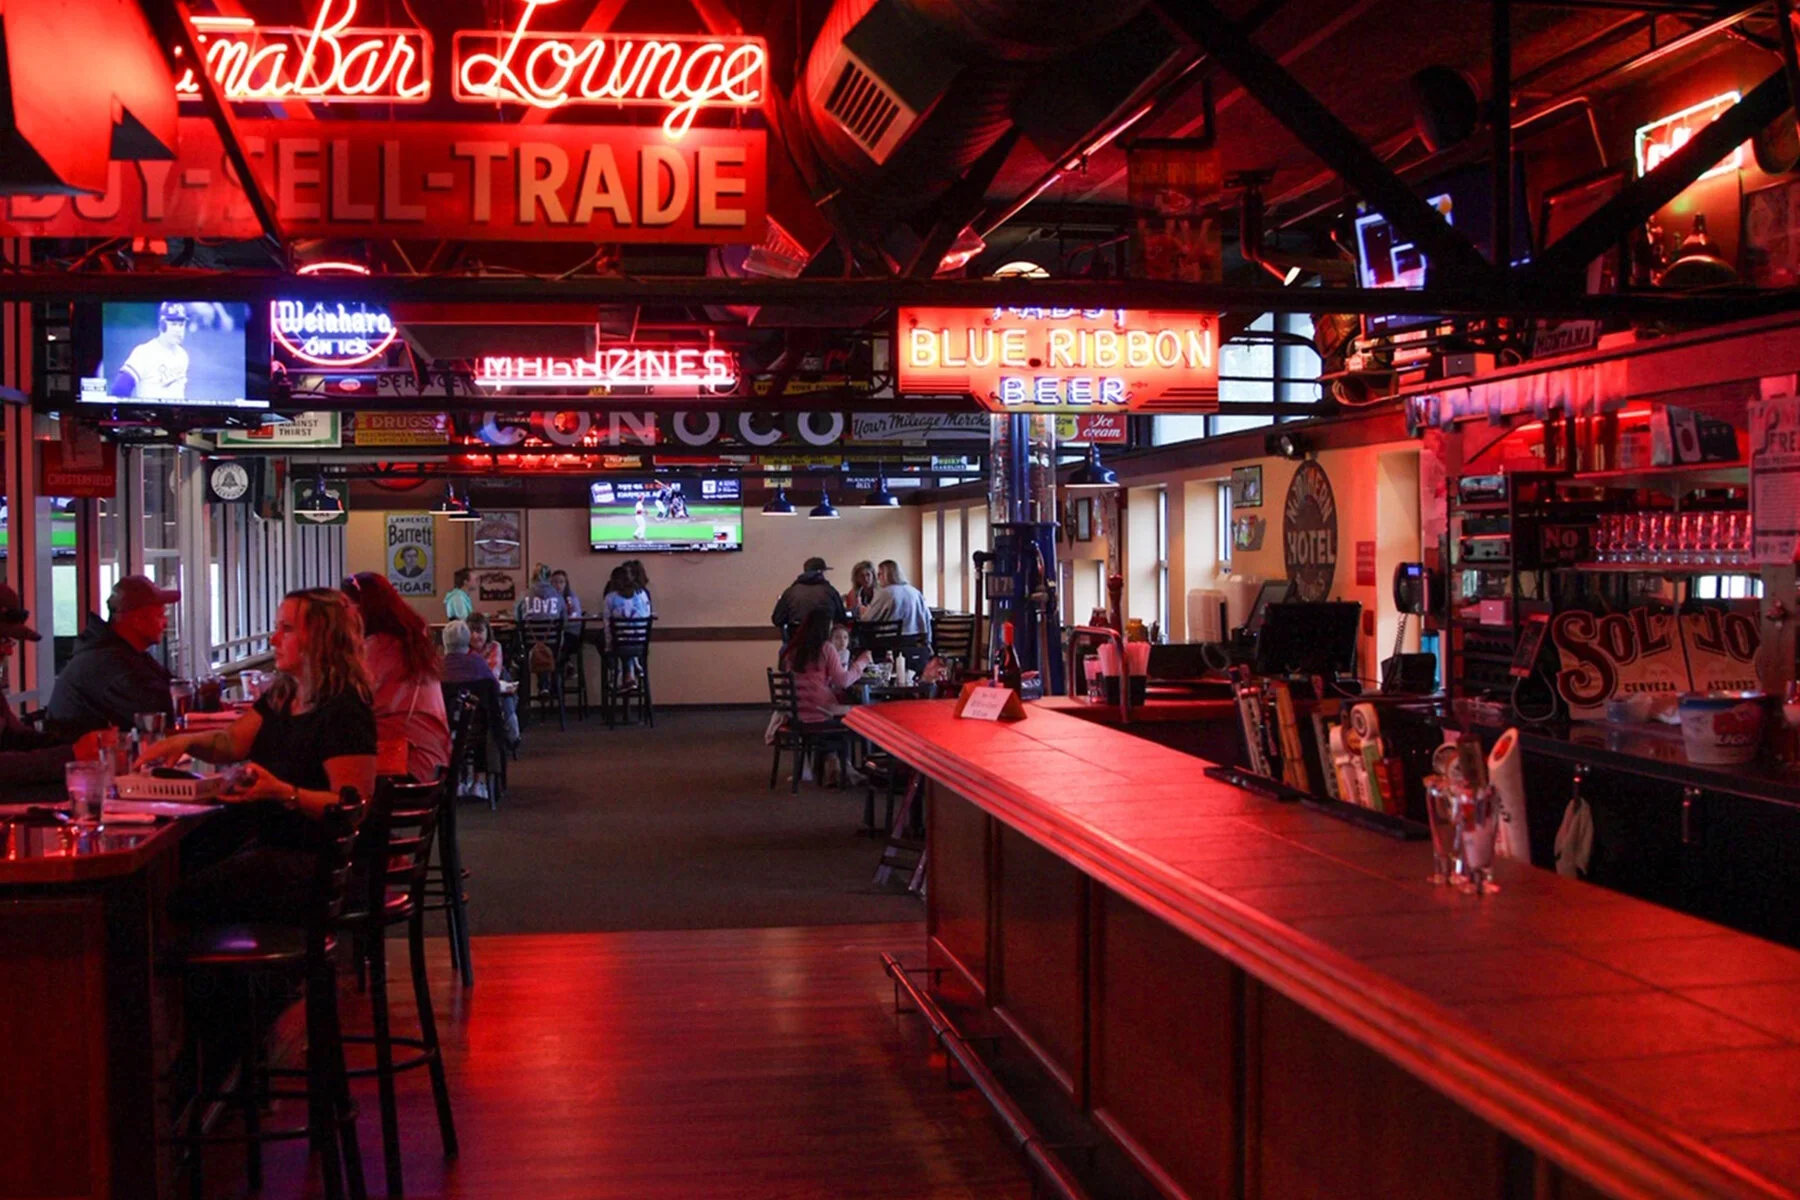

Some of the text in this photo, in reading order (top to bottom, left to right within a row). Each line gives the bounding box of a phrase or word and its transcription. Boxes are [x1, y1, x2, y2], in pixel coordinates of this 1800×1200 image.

[461, 0, 766, 137] Lounge
[909, 328, 1211, 368] BLUE RIBBON
[999, 376, 1128, 405] BEER
[372, 415, 432, 428] DRUGS
[483, 411, 844, 447] CONOCO
[854, 418, 886, 438] Your
[888, 412, 942, 437] Mileage
[1092, 413, 1114, 427] Ice
[279, 428, 313, 436] THIRST
[1082, 427, 1121, 438] cream
[388, 524, 432, 547] Barrett
[1287, 529, 1336, 565] HOTEL
[392, 582, 431, 593] CIGAR
[524, 596, 558, 614] LOVE
[1624, 682, 1676, 693] CERVEZA
